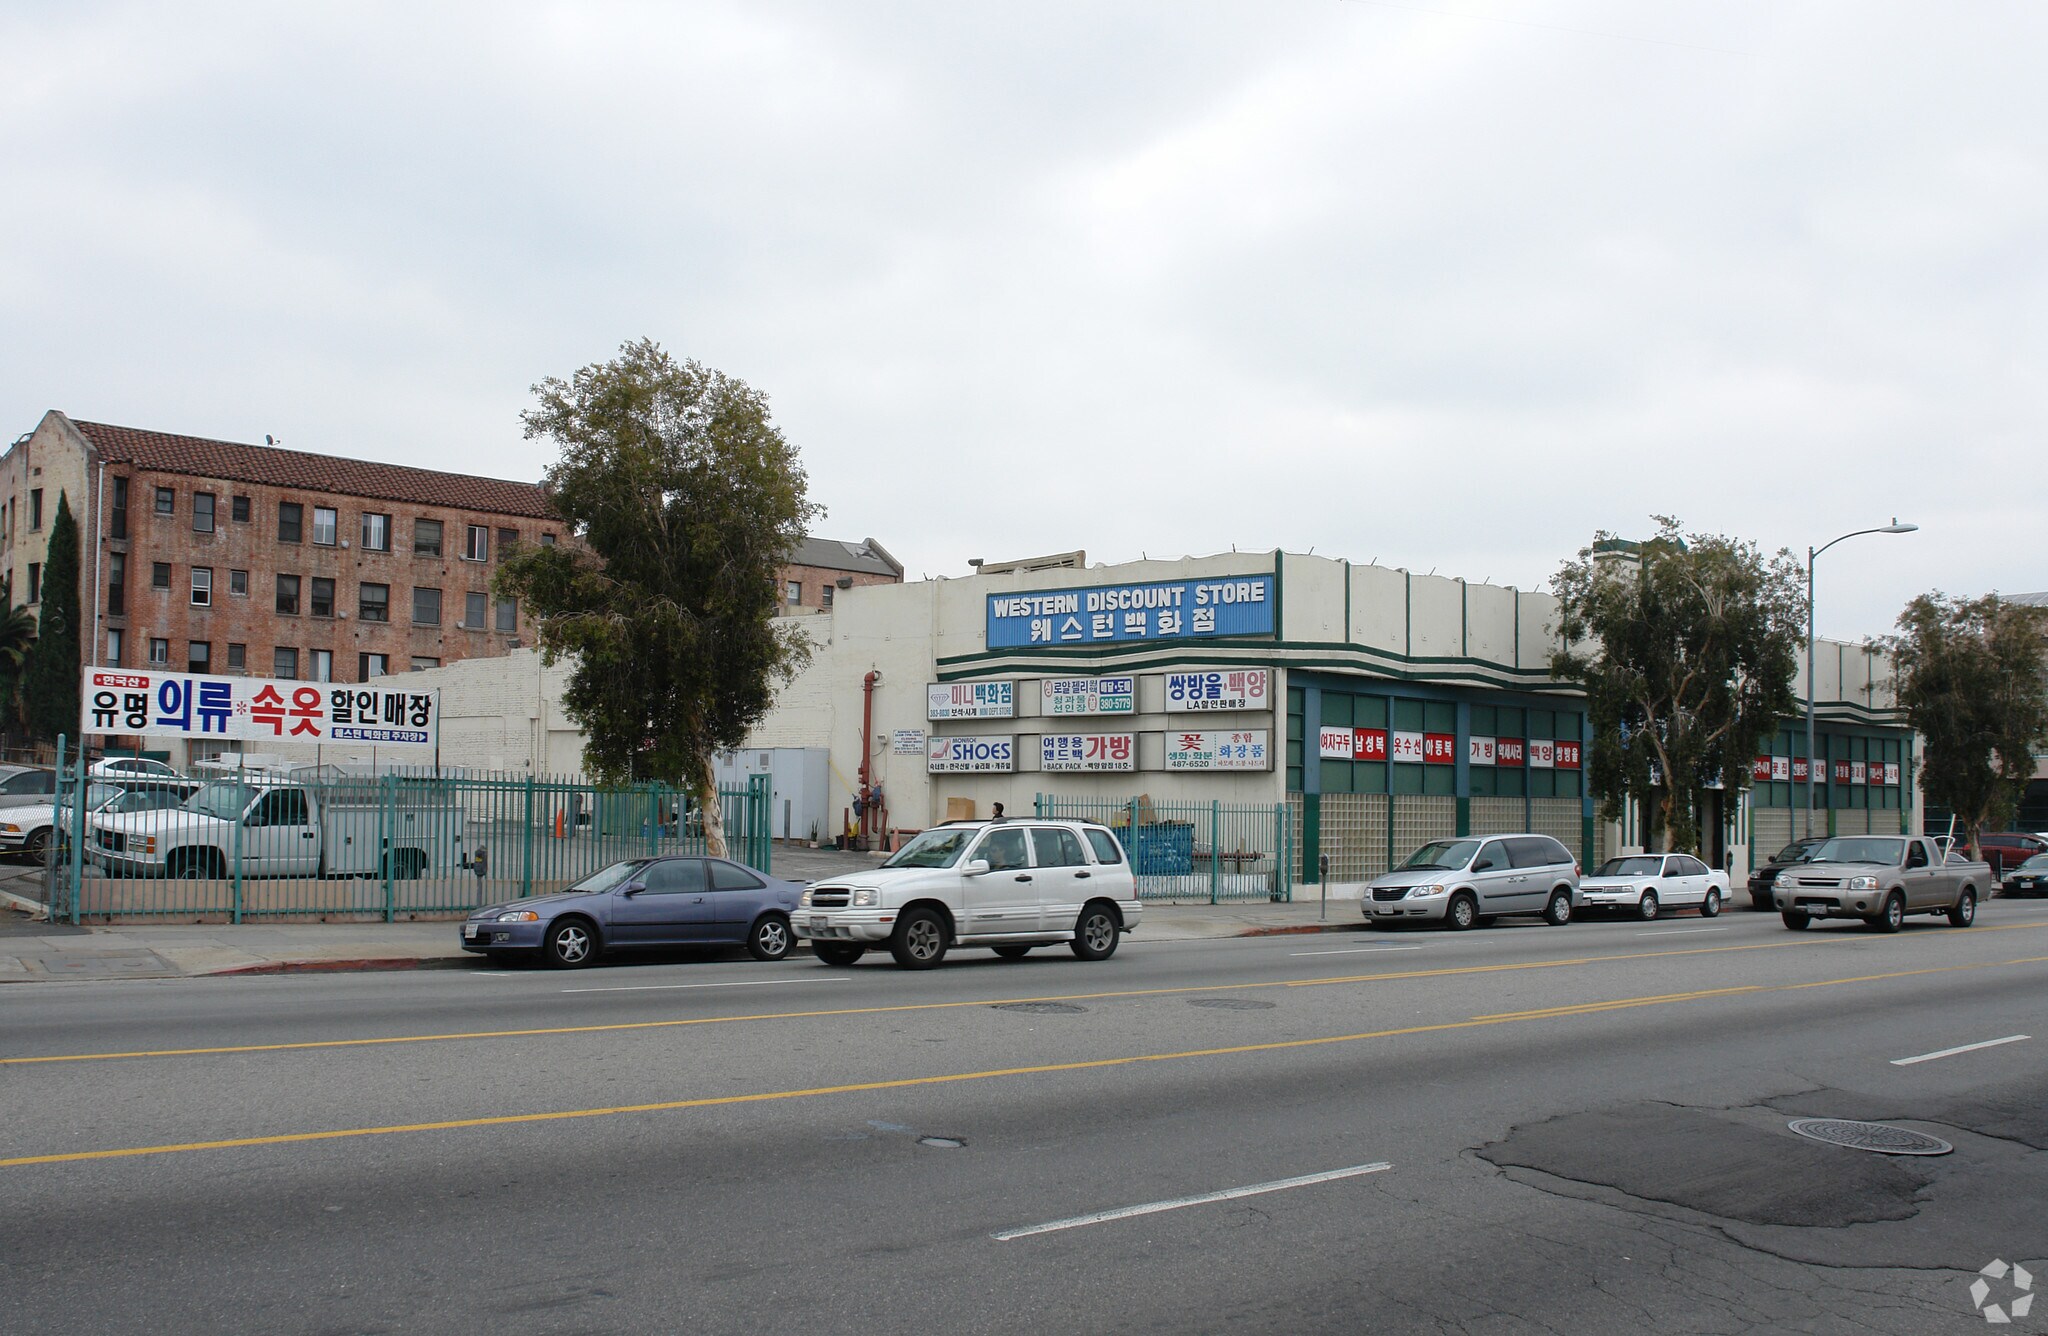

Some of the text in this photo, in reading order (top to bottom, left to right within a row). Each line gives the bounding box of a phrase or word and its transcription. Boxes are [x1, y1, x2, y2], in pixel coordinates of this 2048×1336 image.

[993, 581, 1265, 618] WESTERN DISCOUNT STORE
[102, 674, 140, 688] 한국산
[92, 691, 149, 729] 유명
[1100, 698, 1131, 709] 380-5779
[1085, 735, 1131, 760] 가방
[1177, 734, 1204, 751] 꽃
[1320, 733, 1350, 751] 여자구두
[1355, 735, 1384, 753] 남성복
[1425, 739, 1452, 757] 아동복
[952, 743, 1010, 760] SHOES
[1218, 744, 1264, 758] 화장품
[1065, 762, 1082, 770] PACK
